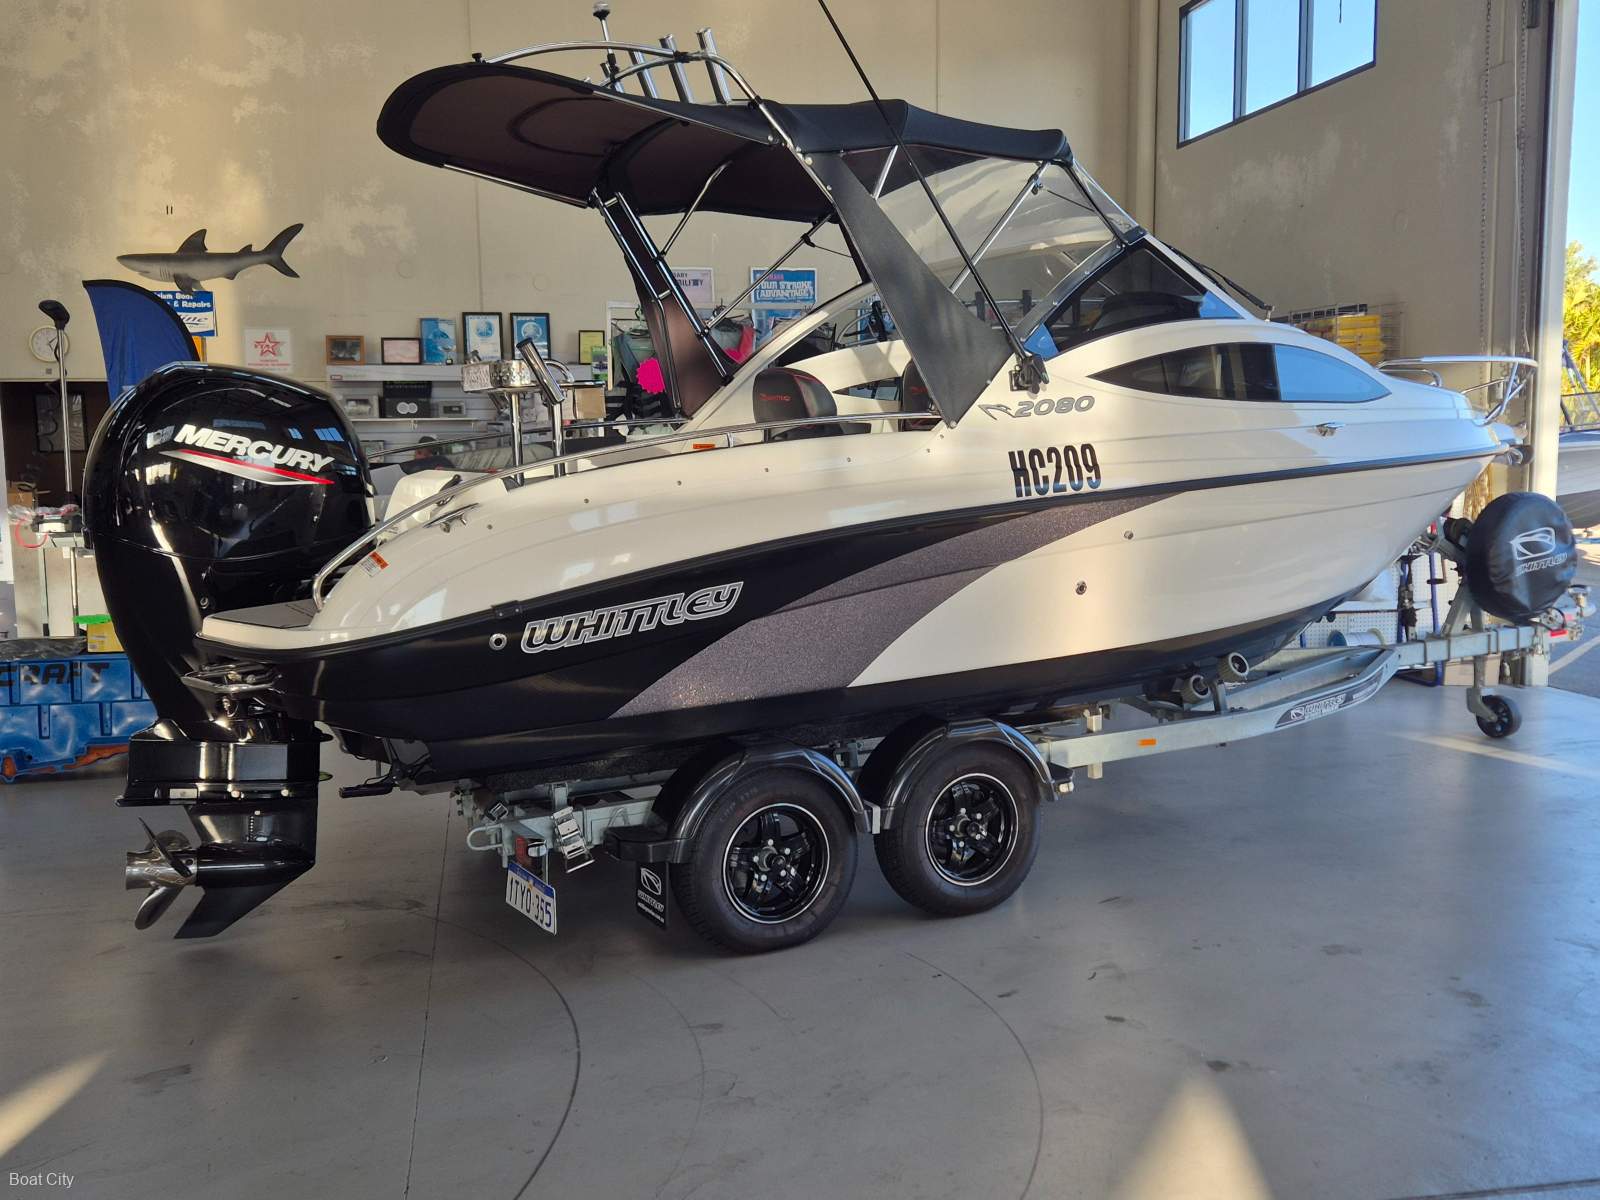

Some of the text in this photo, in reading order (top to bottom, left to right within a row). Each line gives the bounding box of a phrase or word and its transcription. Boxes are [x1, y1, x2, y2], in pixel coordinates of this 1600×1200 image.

[174, 424, 335, 473] MERCURY
[1008, 443, 1102, 497] HC209
[520, 581, 744, 654] WHITTLEY
